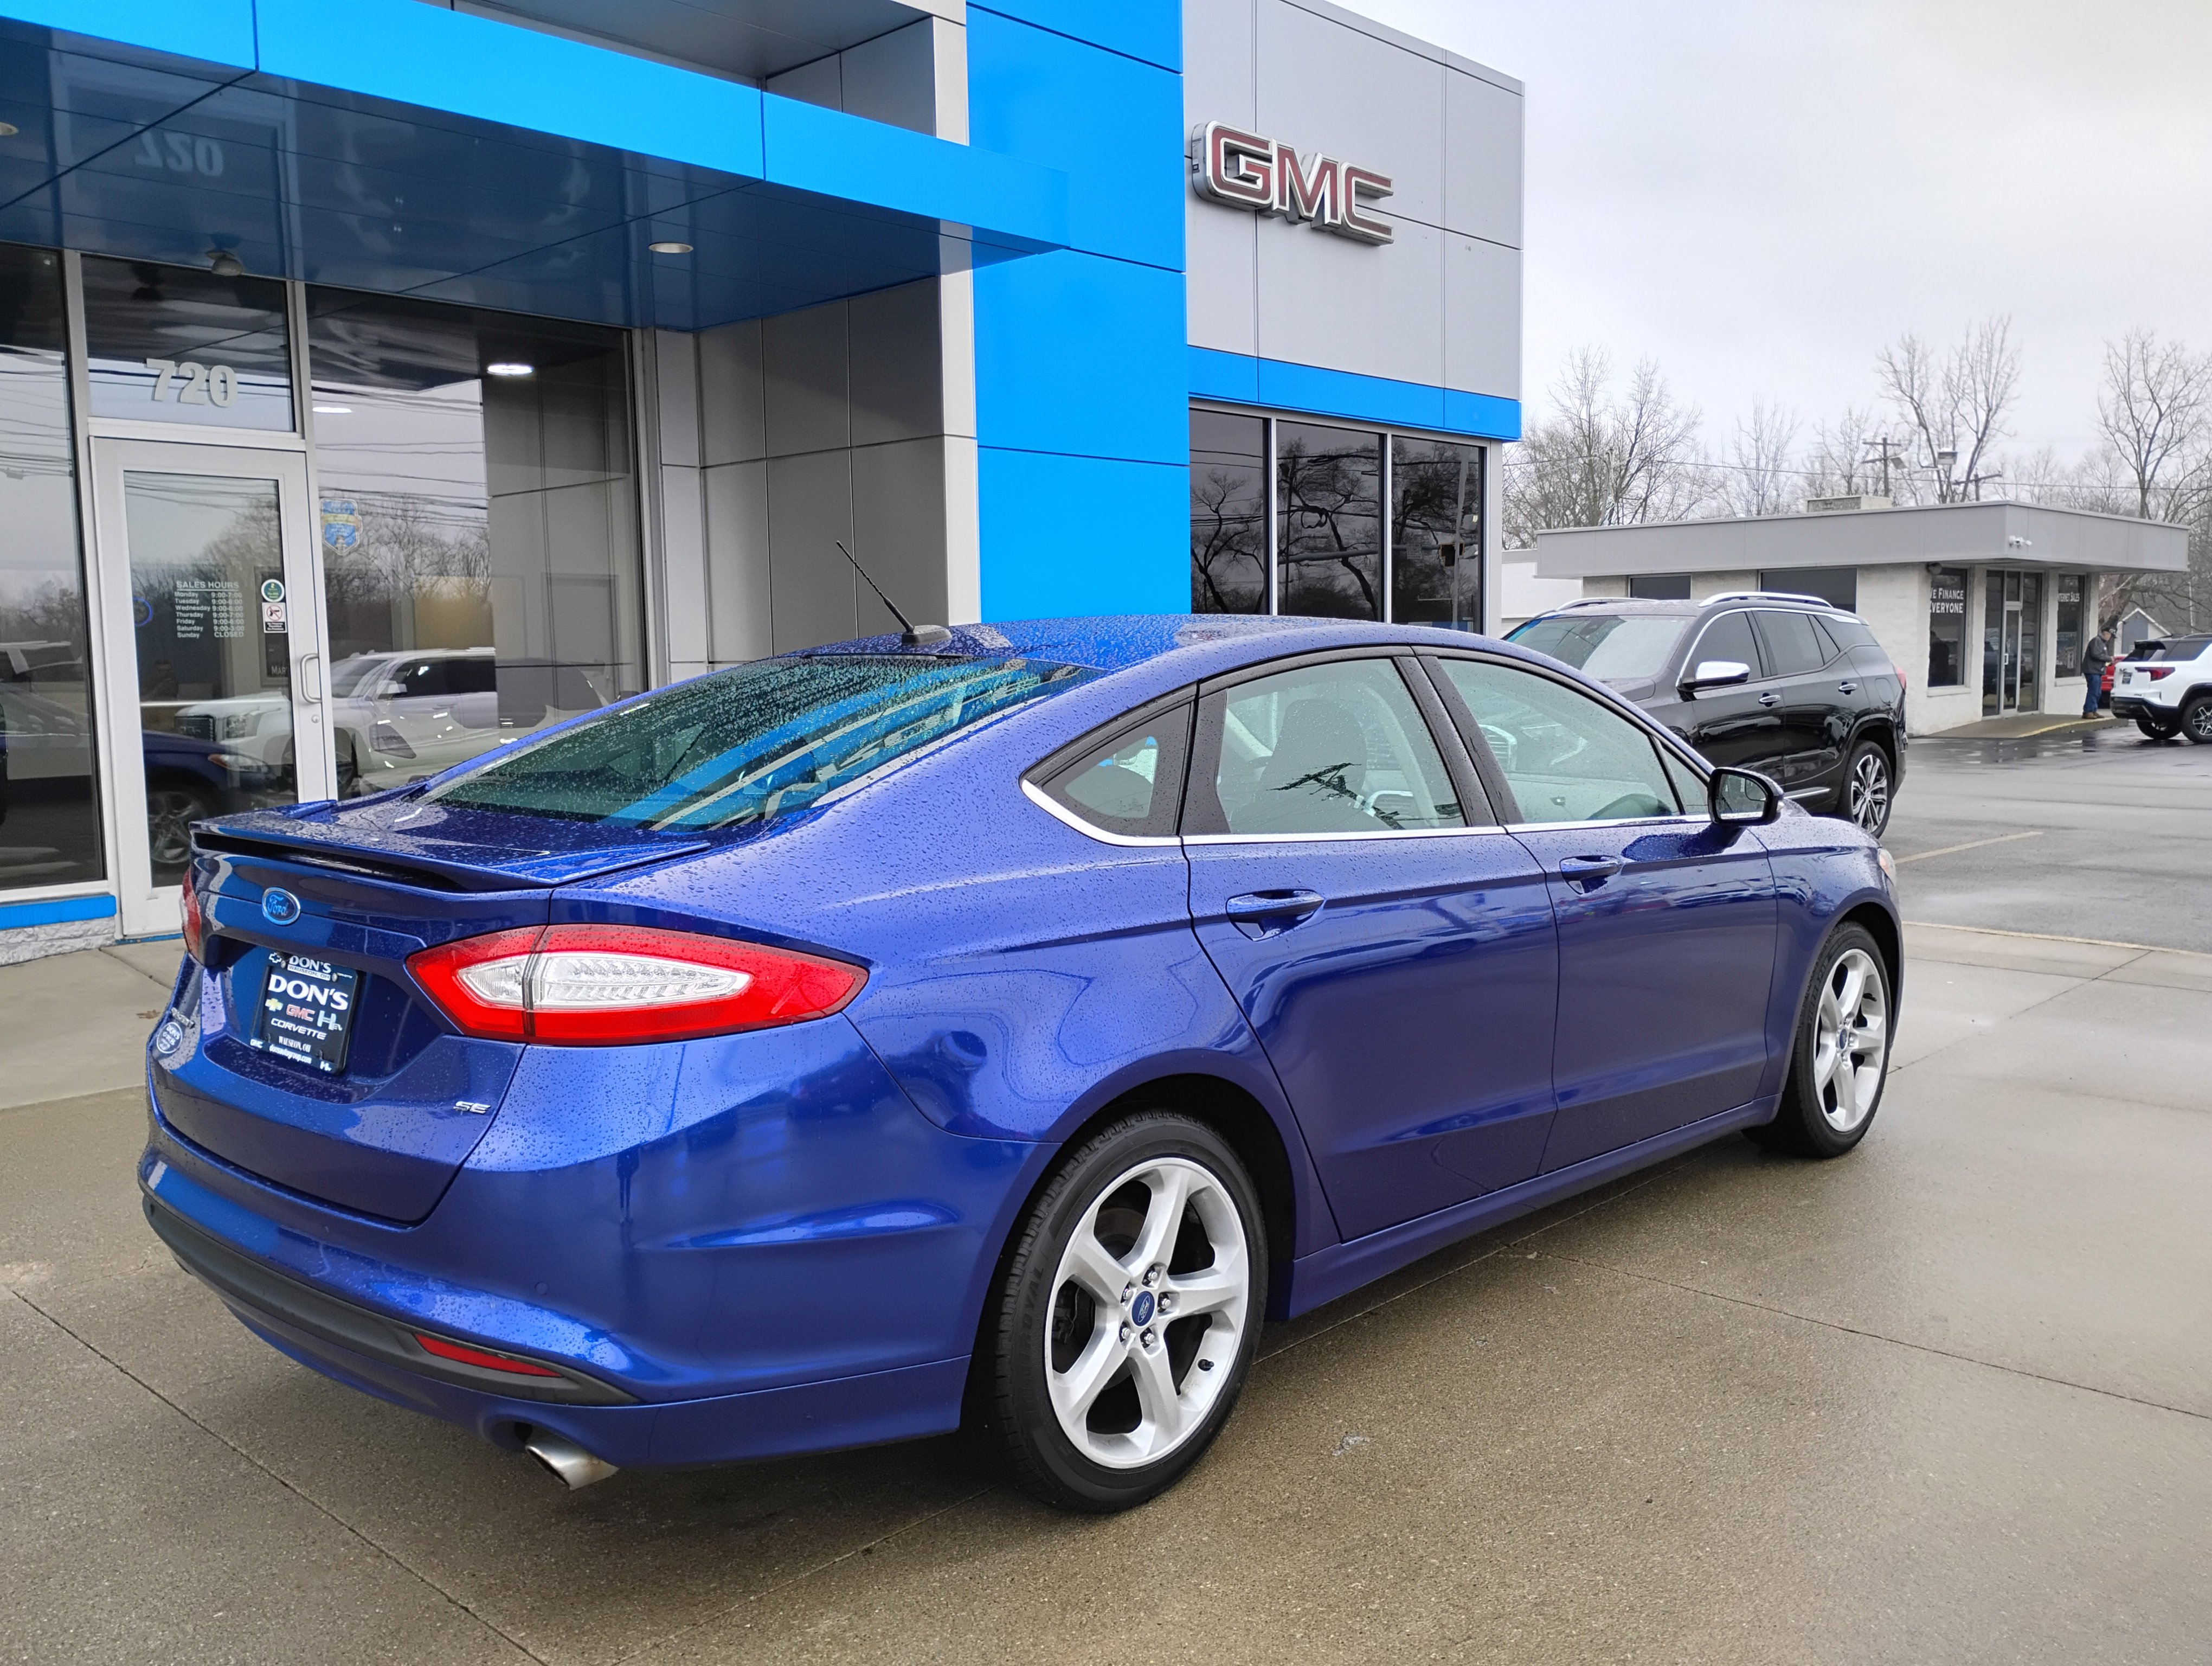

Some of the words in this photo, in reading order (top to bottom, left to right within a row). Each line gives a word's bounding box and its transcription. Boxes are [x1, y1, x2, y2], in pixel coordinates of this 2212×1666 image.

[1192, 120, 1394, 246] GMC
[145, 358, 237, 407] 720
[176, 580, 205, 588] SALES
[208, 581, 239, 589] HOURS
[1938, 587, 1964, 600] FINANCE
[267, 894, 289, 917] Ford
[289, 955, 332, 973] DON'S
[268, 973, 348, 1010] DON'S
[286, 1004, 316, 1022] GMC
[271, 1017, 327, 1040] CORVETTE
[303, 1043, 312, 1053] OH
[453, 1101, 491, 1114] SE
